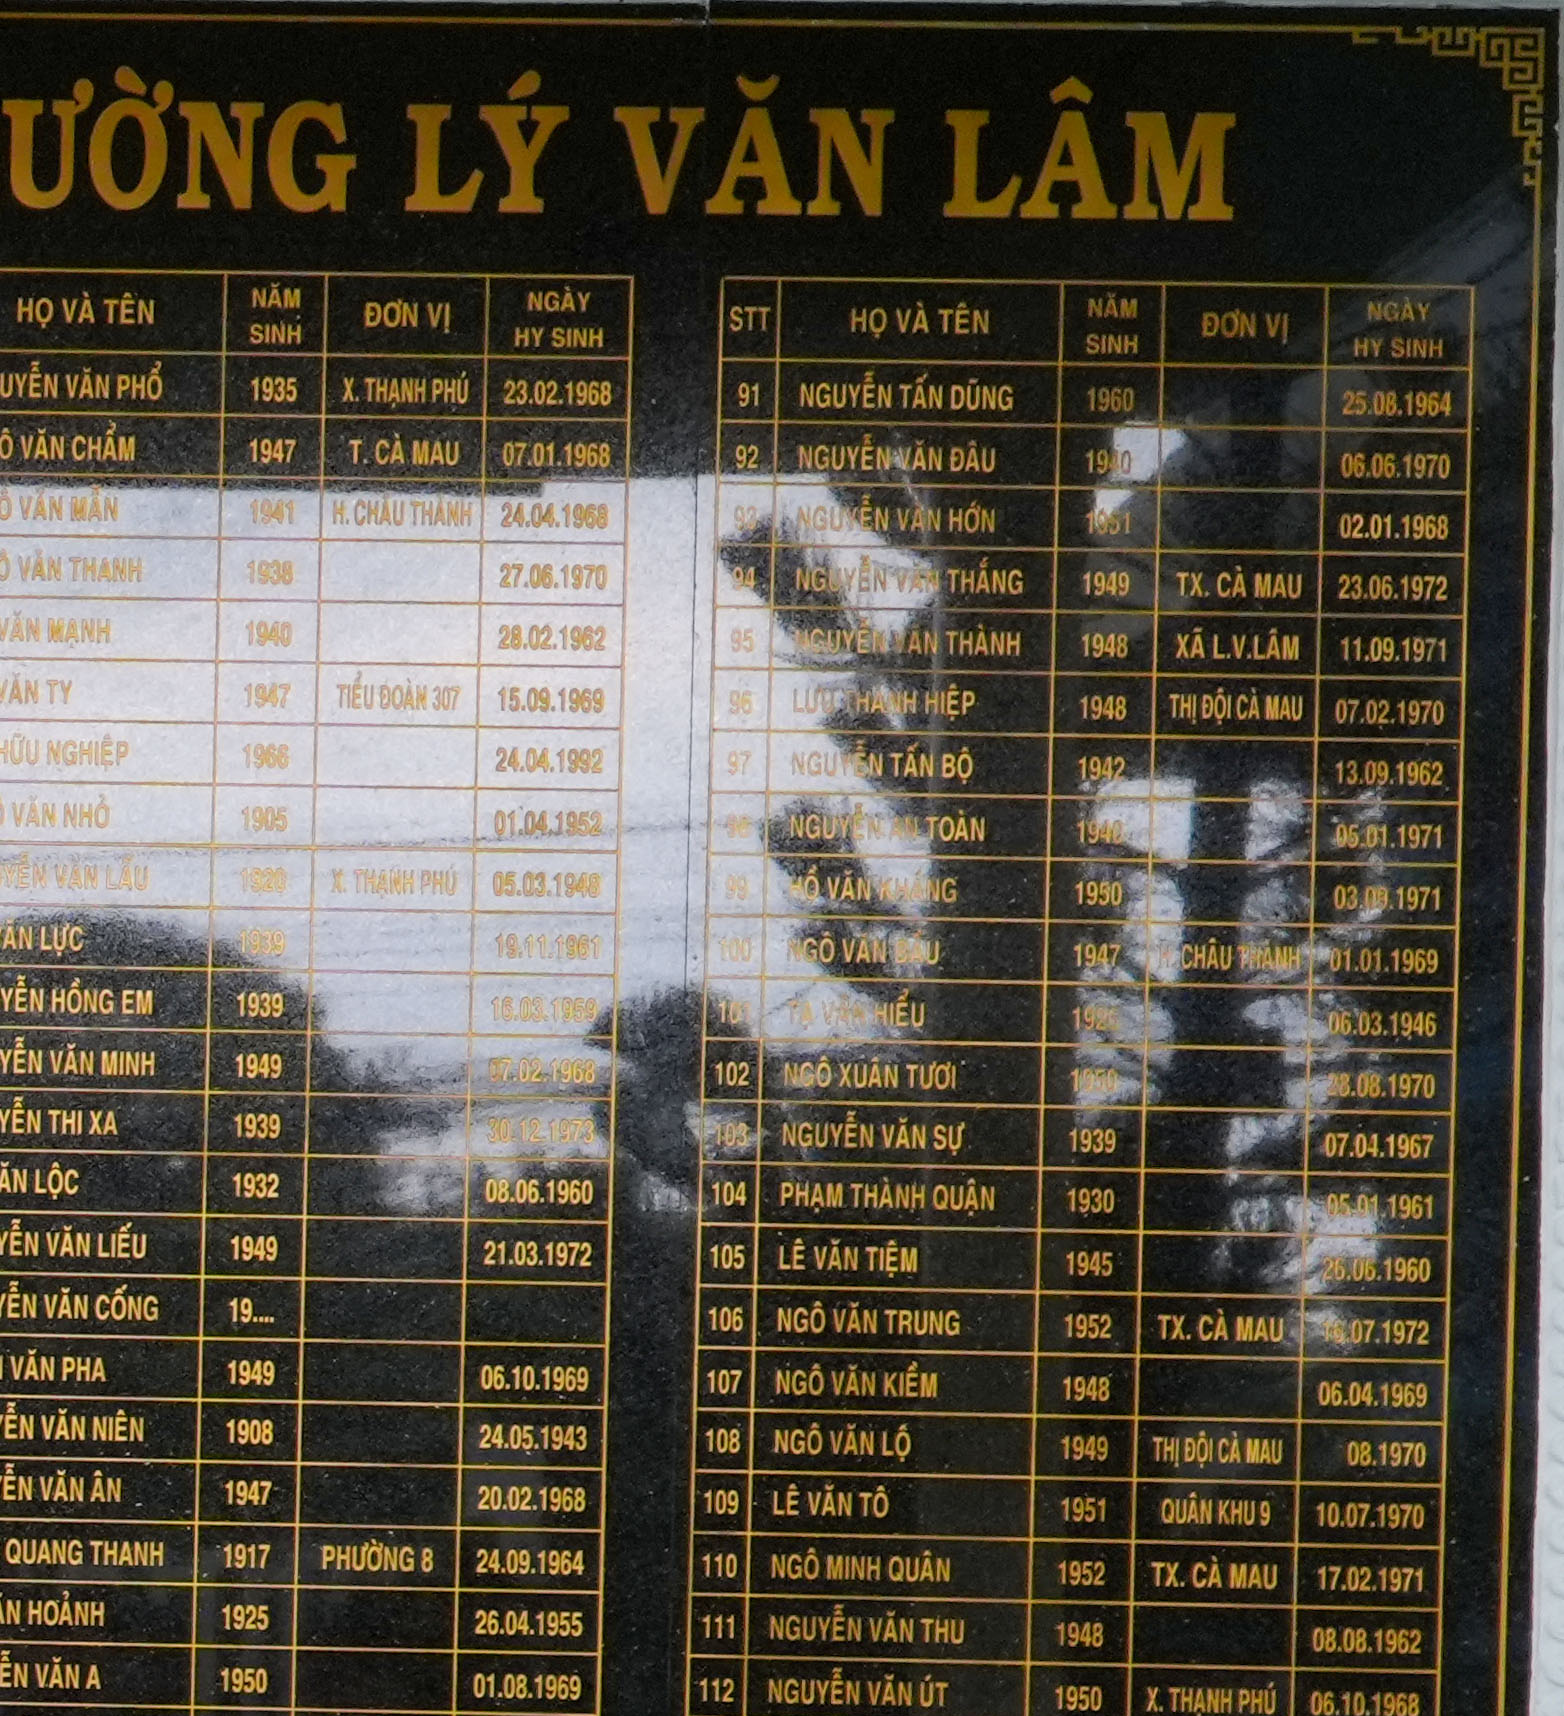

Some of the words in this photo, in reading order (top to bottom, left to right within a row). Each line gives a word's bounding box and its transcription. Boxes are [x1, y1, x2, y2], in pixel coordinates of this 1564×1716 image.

[404, 71, 570, 214] LÝ
[614, 76, 894, 217] VĂN
[943, 77, 1236, 222] LÂM
[16, 297, 55, 329] HỌ
[61, 291, 96, 324] VÀ
[102, 291, 155, 326] TÊN
[251, 283, 301, 310] NĂM
[527, 286, 591, 312] NGÀY
[1087, 293, 1139, 319] NĂM
[1367, 297, 1430, 323] NGÀY
[363, 298, 419, 329] ĐƠN
[426, 302, 451, 333] VỊ
[729, 305, 772, 333] STT
[849, 307, 888, 339] HỌ
[895, 301, 930, 334] VÀ
[937, 301, 990, 336] TÊN
[1200, 308, 1258, 339] ĐƠN
[1265, 313, 1289, 343] VỊ
[249, 322, 303, 345] SINH
[514, 327, 544, 347] HY
[551, 326, 604, 349] SINH
[1085, 333, 1139, 356] SINH
[1353, 338, 1383, 357] HY
[1391, 336, 1444, 359] SINH
[65, 367, 111, 400] VĂN
[250, 375, 298, 404] 1935
[342, 377, 359, 403] X.
[363, 377, 427, 408] THẠNH
[430, 371, 470, 405] PHÚ
[503, 379, 613, 407] 23.02.1968
[710, 1243, 746, 1270] 105
[778, 1237, 806, 1271] LÊ
[813, 1238, 859, 1271] VĂN
[865, 1239, 919, 1279] TIỆM
[1065, 1250, 1114, 1277] 1945
[9, 1348, 55, 1382] VĂN
[61, 1355, 107, 1382] PHA
[227, 1359, 276, 1387] 1949
[479, 1364, 590, 1392] 06.10.1969
[701, 1553, 738, 1579] 110
[770, 1547, 821, 1581] NGÔ
[825, 1554, 882, 1581] MINH
[1057, 1560, 1106, 1587] 1952
[1151, 1561, 1185, 1588] TX.
[1190, 1556, 1223, 1589] CÀ
[1228, 1562, 1278, 1590] MAU
[1317, 1565, 1425, 1593] 17.02.1971
